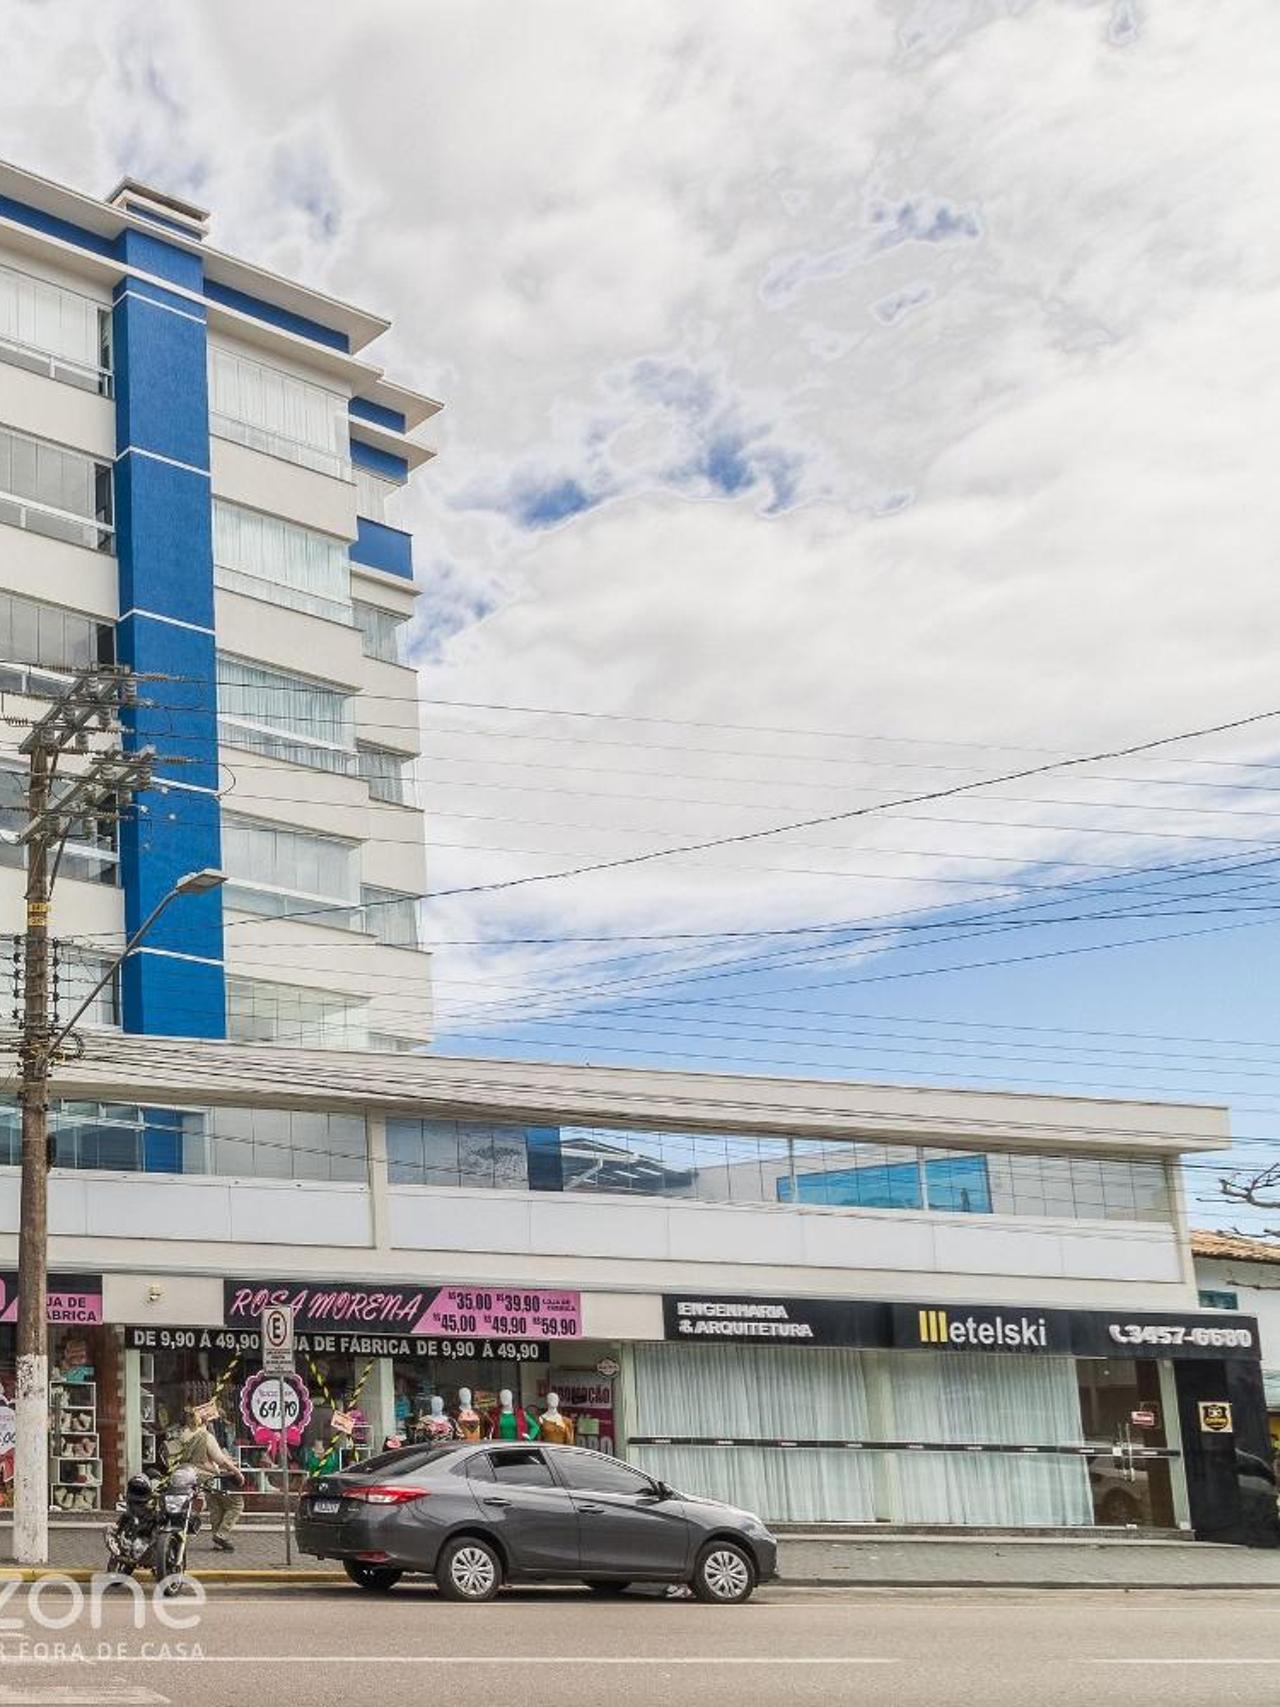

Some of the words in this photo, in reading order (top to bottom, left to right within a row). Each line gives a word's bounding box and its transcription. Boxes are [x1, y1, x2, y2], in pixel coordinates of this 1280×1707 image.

[68, 1296, 86, 1308] DE
[307, 1291, 424, 1322] MORENA
[676, 1301, 790, 1319] ENGENHARIA
[47, 1310, 97, 1322] BRICA
[491, 1315, 527, 1336] 49,90
[272, 1317, 282, 1339] E
[133, 1329, 157, 1347] DE
[160, 1330, 196, 1350] 9,90
[215, 1332, 260, 1353] 49,90
[313, 1335, 336, 1352] DE
[416, 1339, 438, 1356] DE
[441, 1341, 475, 1359] 9,90
[497, 1342, 540, 1362] 49,90
